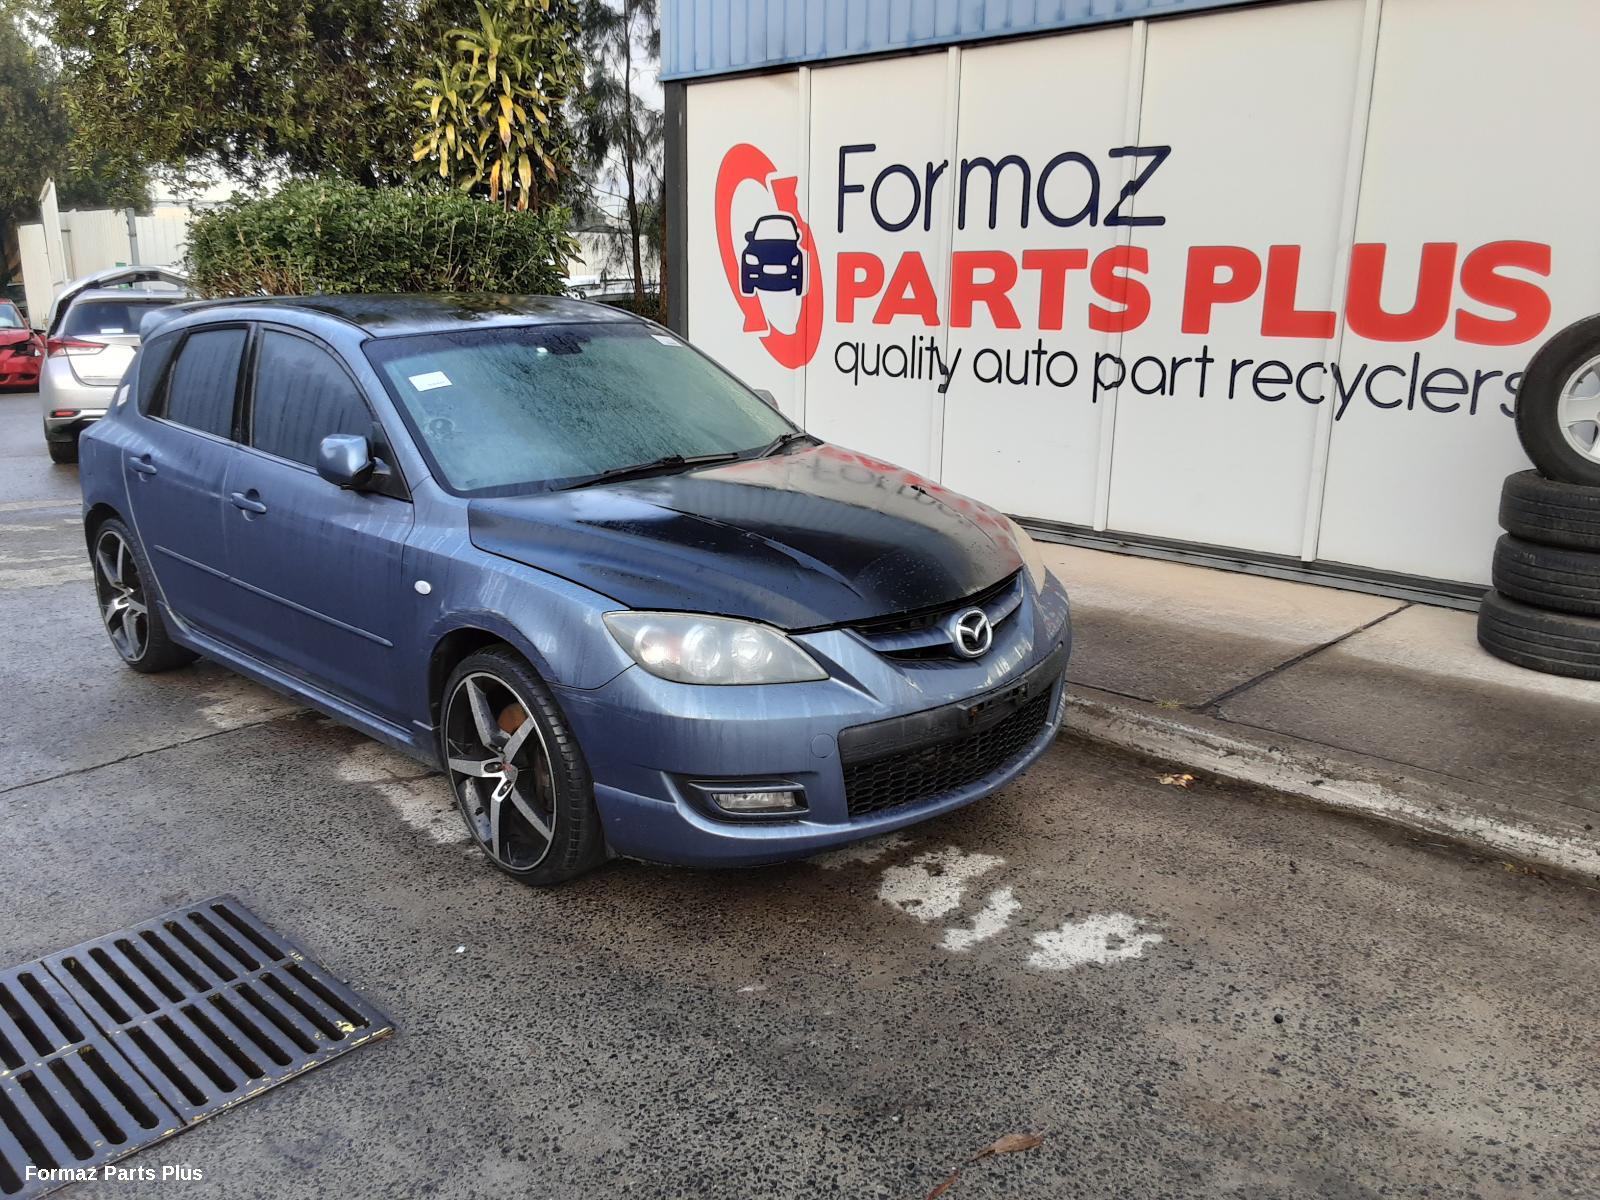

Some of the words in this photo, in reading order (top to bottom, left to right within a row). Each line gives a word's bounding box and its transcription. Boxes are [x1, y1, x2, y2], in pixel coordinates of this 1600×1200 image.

[838, 144, 1171, 233] Formaz
[836, 245, 1151, 333] PARTS
[1182, 240, 1551, 346] PLUS
[835, 335, 961, 394] quality
[973, 339, 1077, 387] auto
[1093, 345, 1214, 403] part
